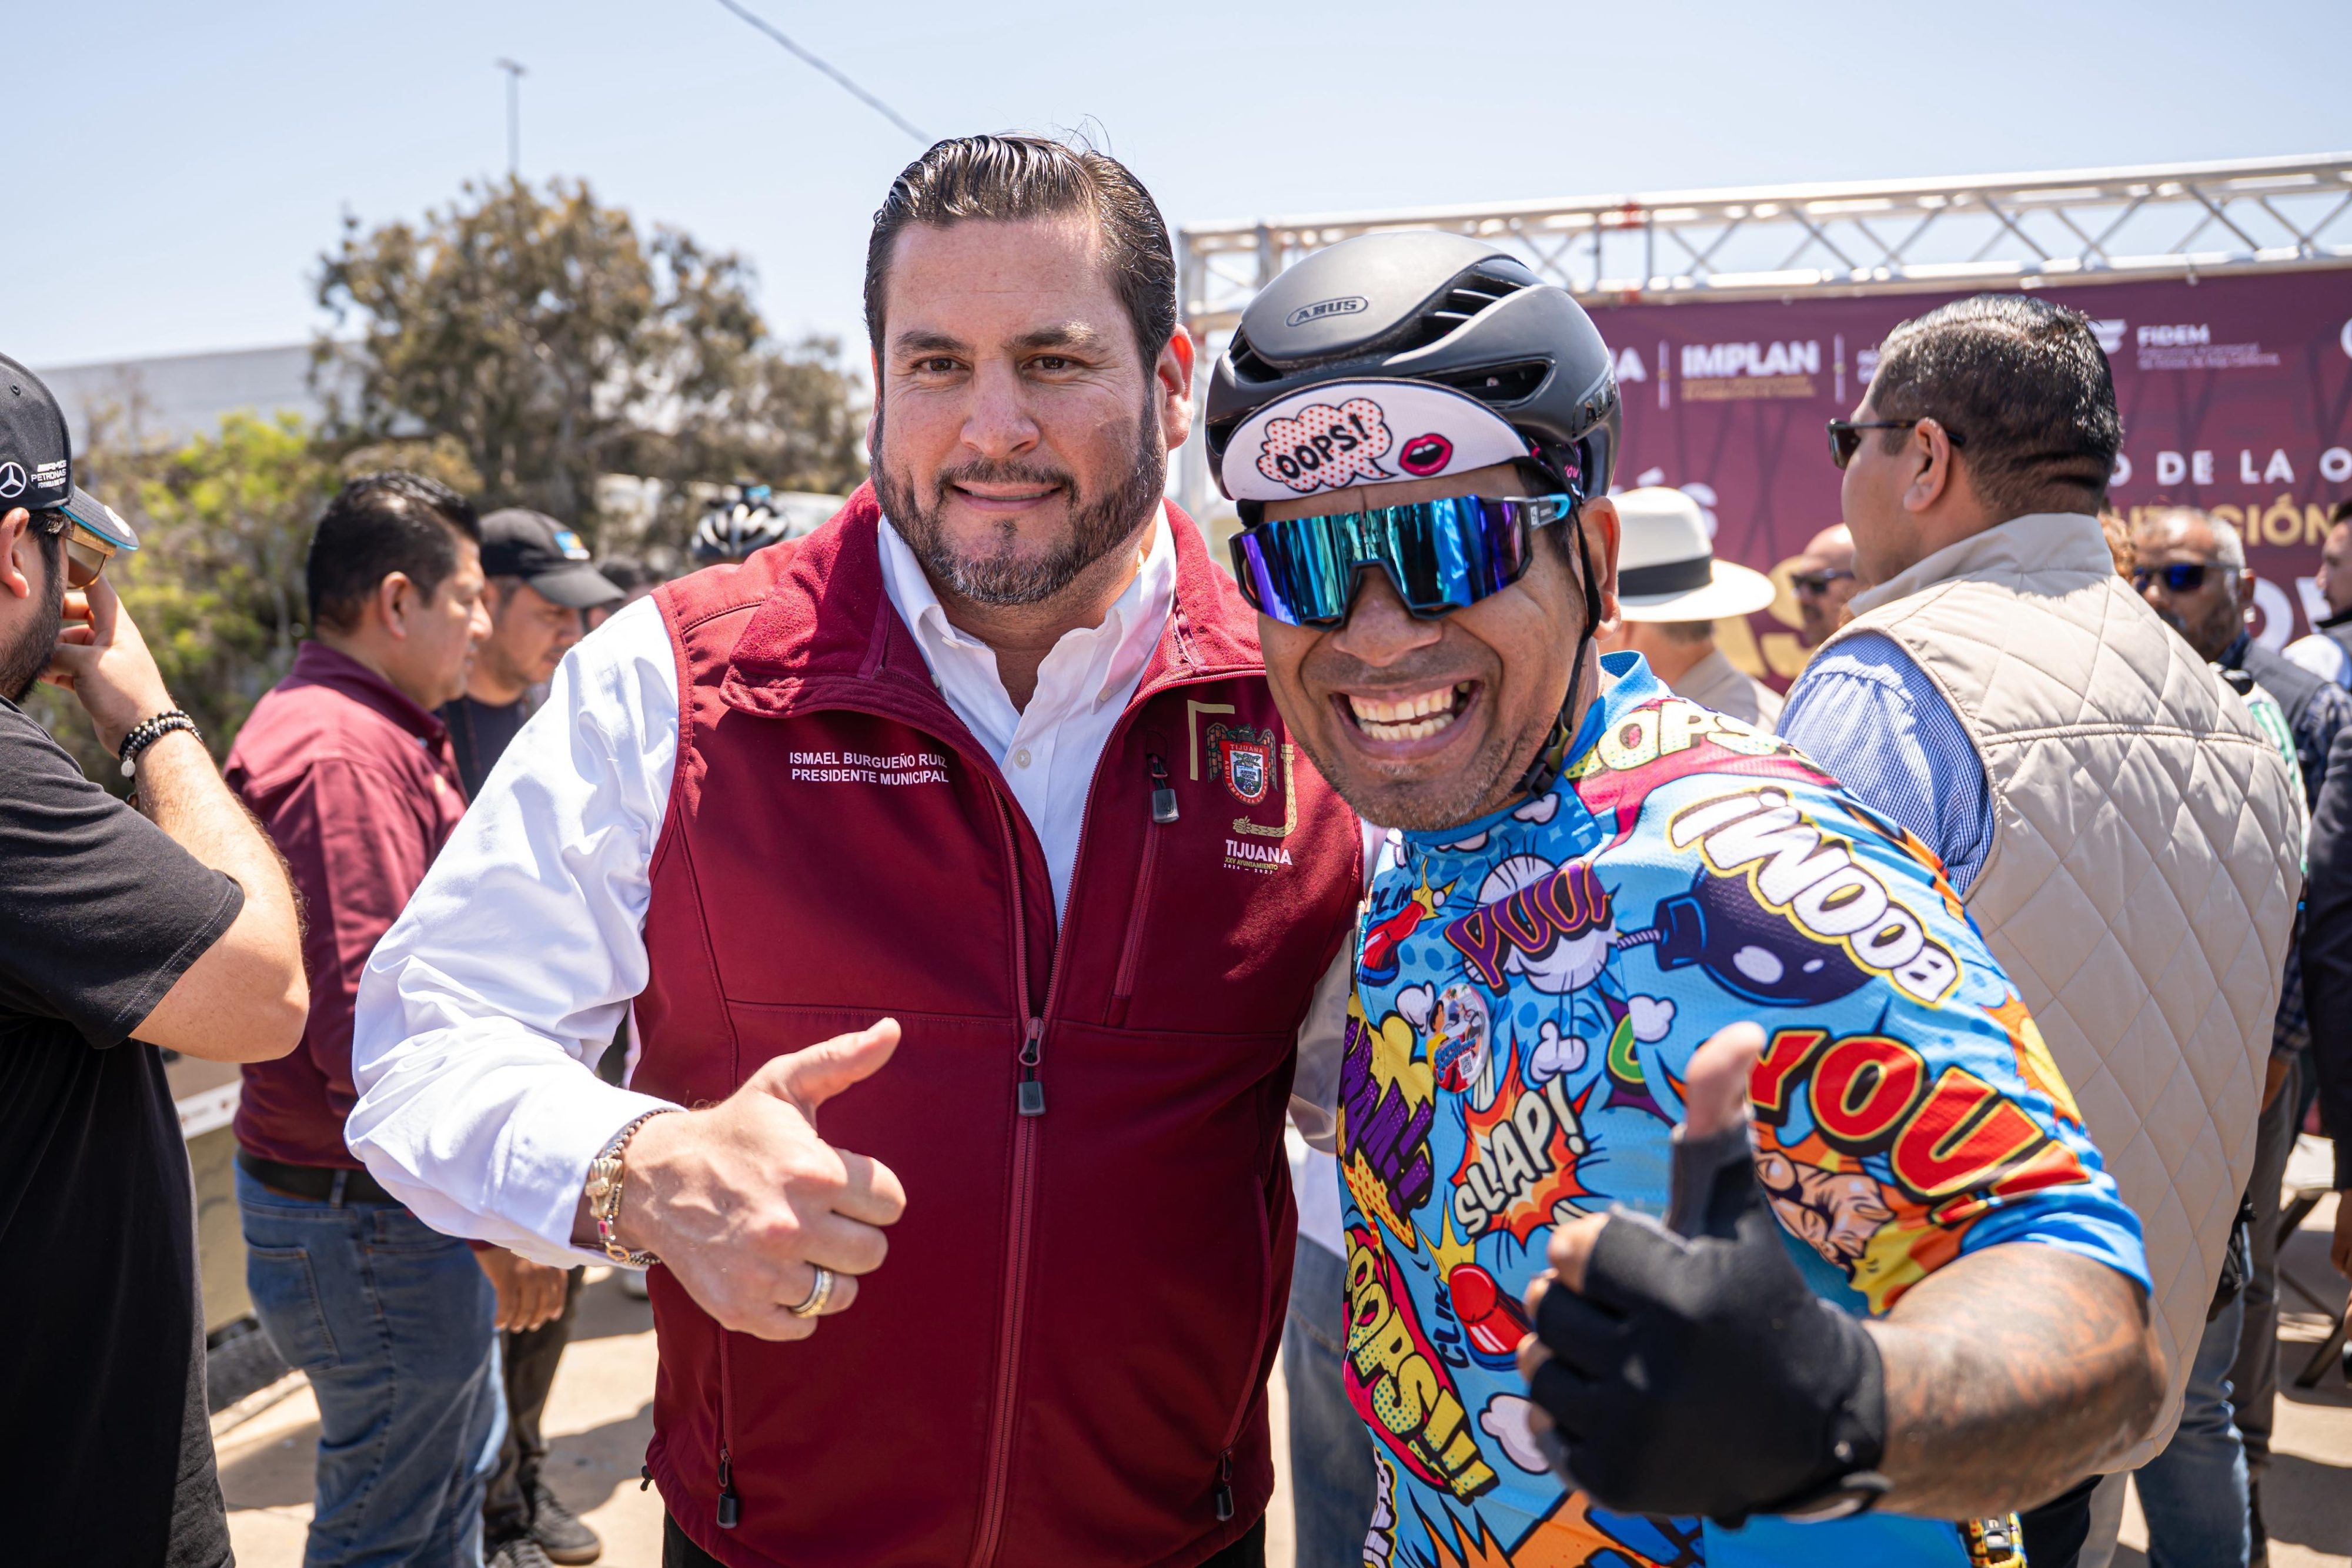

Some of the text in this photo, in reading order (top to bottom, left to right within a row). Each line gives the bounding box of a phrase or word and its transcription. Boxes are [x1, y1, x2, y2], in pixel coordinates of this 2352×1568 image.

[1295, 300, 1357, 322] ABUS
[2136, 324, 2210, 347] FIDEM
[1681, 340, 1821, 379] IMPLAN
[1275, 413, 1370, 479] OOPS!
[31, 469, 66, 482] PETRONAS
[2156, 450, 2215, 486] DE
[2239, 448, 2296, 484] LA
[1230, 744, 1264, 754] TIJUANA
[789, 752, 948, 769] ISMAEL BURGUEÑO RUIZ
[791, 768, 949, 785] PRESIDENTE MUNICIPAL
[1225, 839, 1293, 866] TIJUANA
[1237, 860, 1278, 871] AYUNTAMIENTO
[1454, 1075, 1585, 1235] SLAP!
